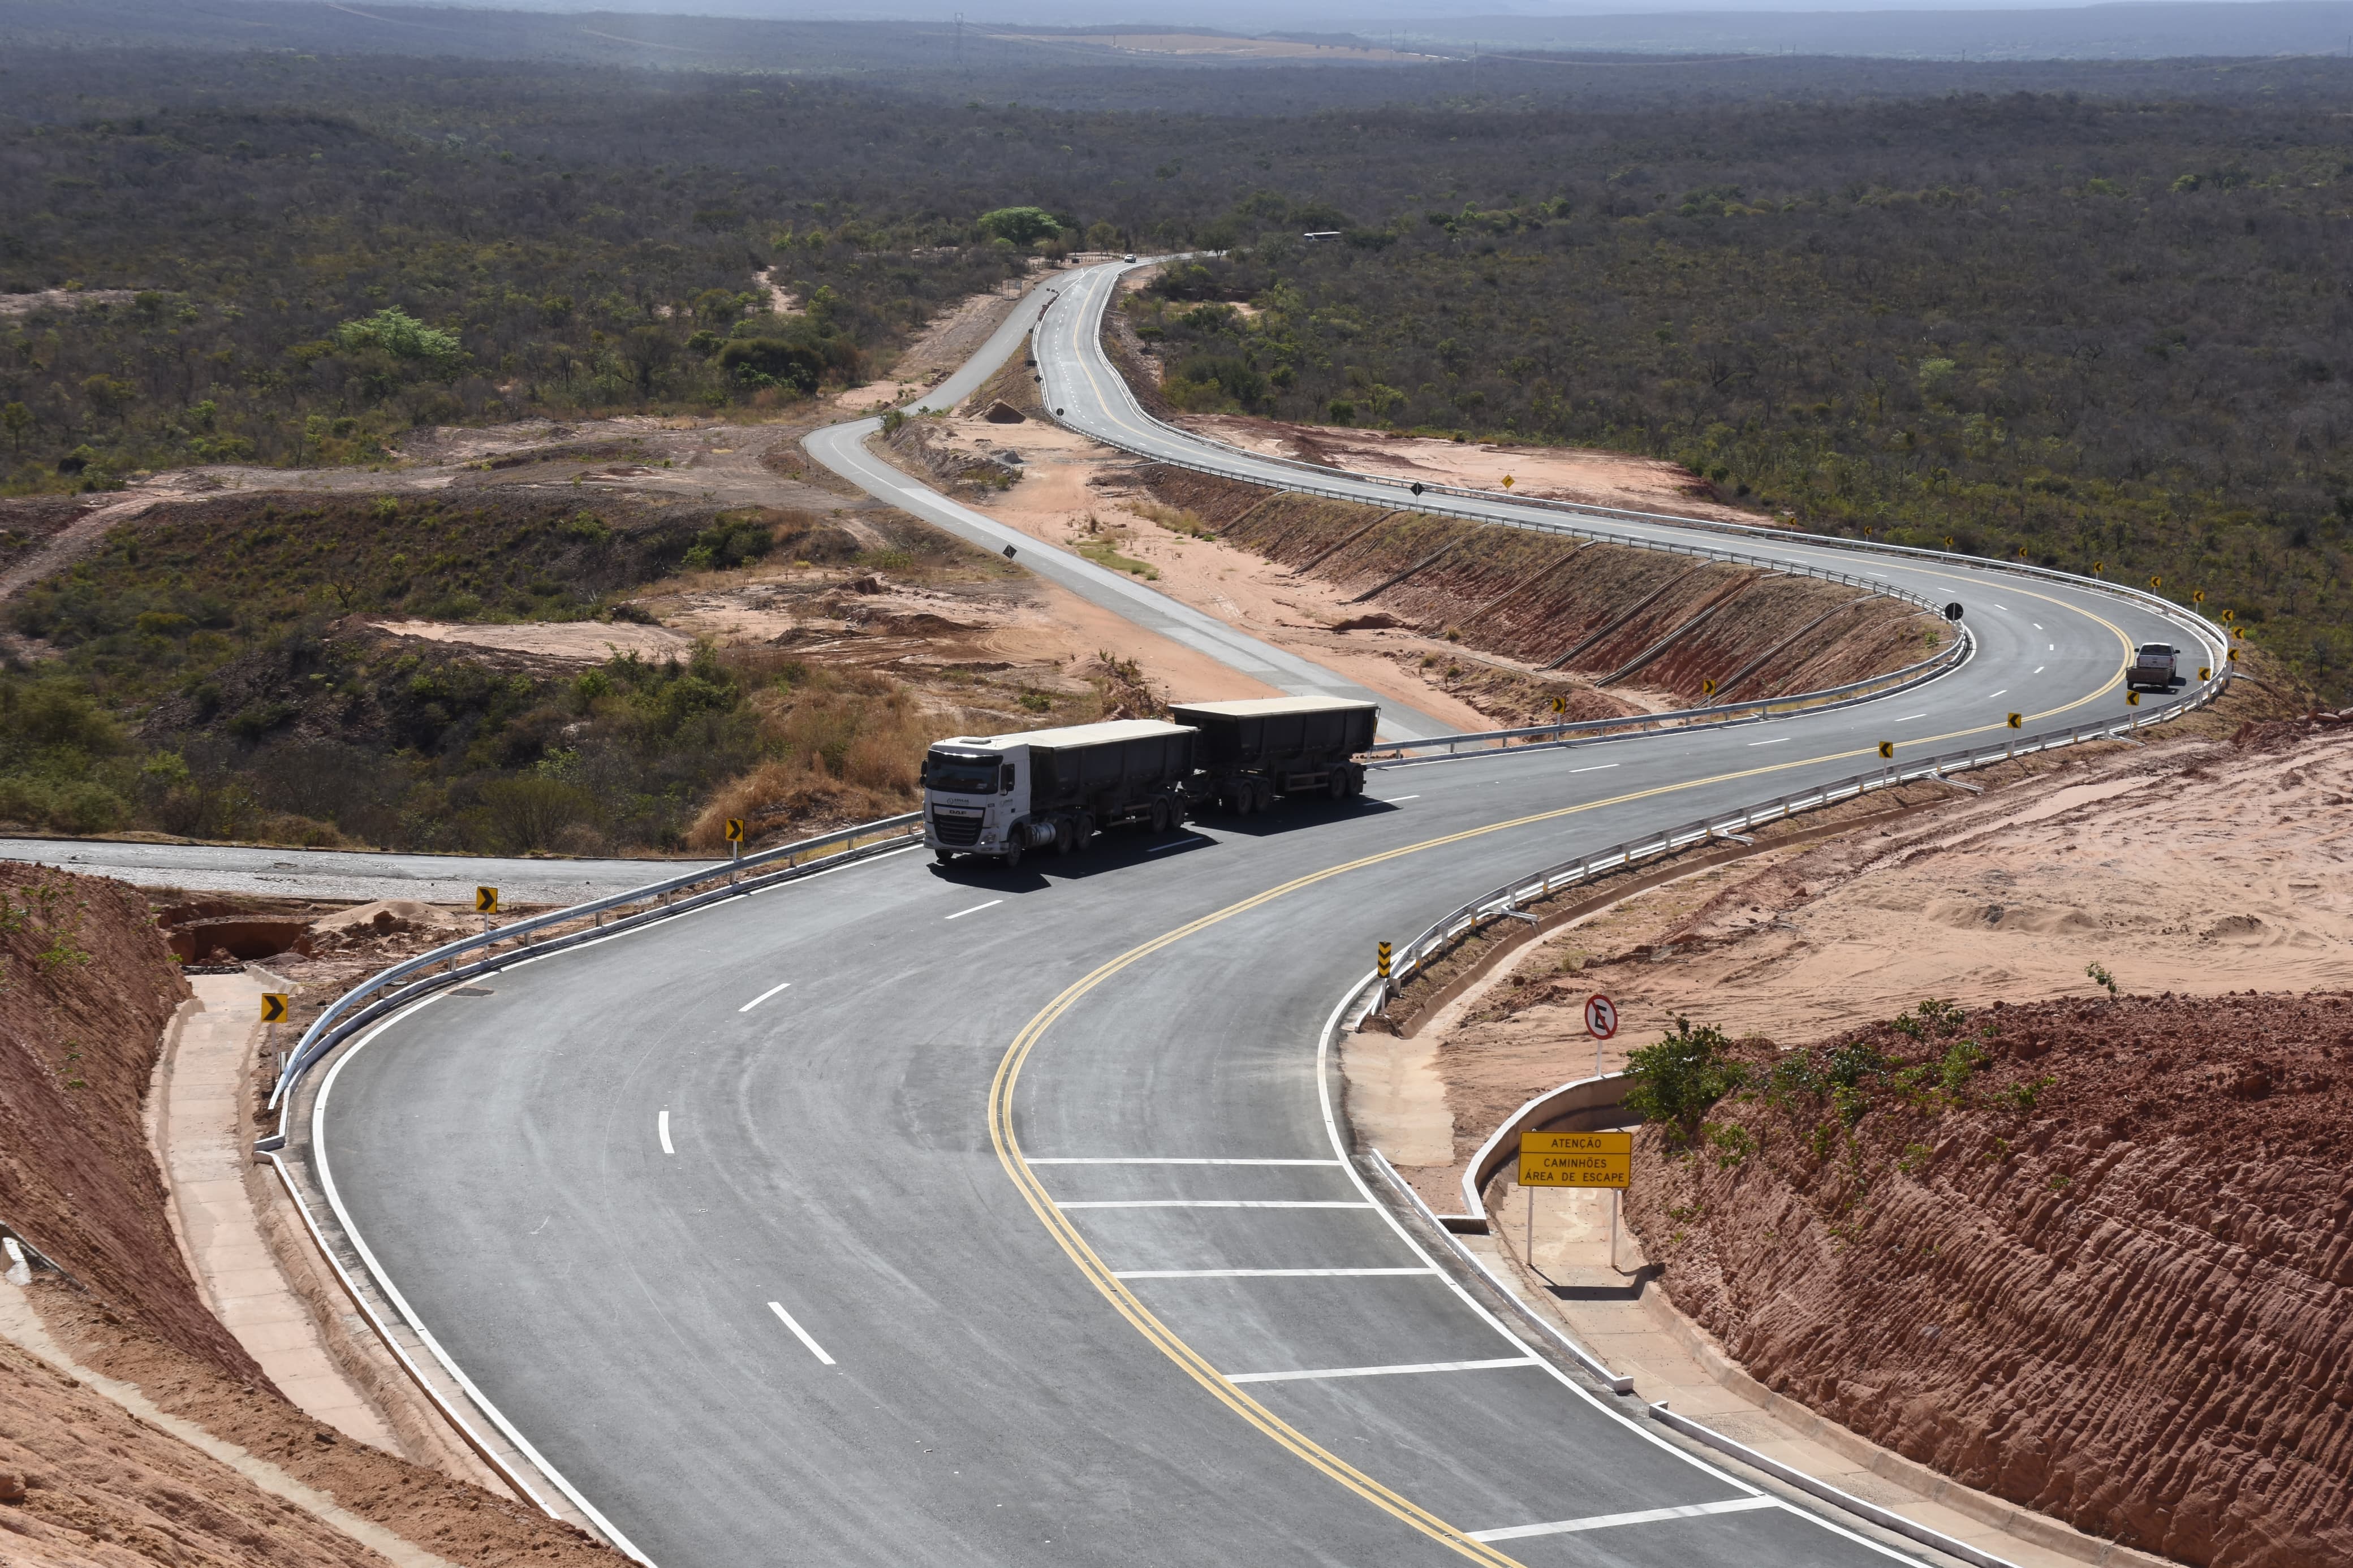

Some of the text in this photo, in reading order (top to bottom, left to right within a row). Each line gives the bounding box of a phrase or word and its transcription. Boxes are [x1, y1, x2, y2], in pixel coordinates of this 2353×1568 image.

[1594, 1004, 1607, 1030] E
[1551, 1137, 1601, 1150] ATENÇÃO
[1544, 1157, 1606, 1168] CAMINHÕES
[1525, 1168, 1624, 1182] ÁREA DE ESCAPE
